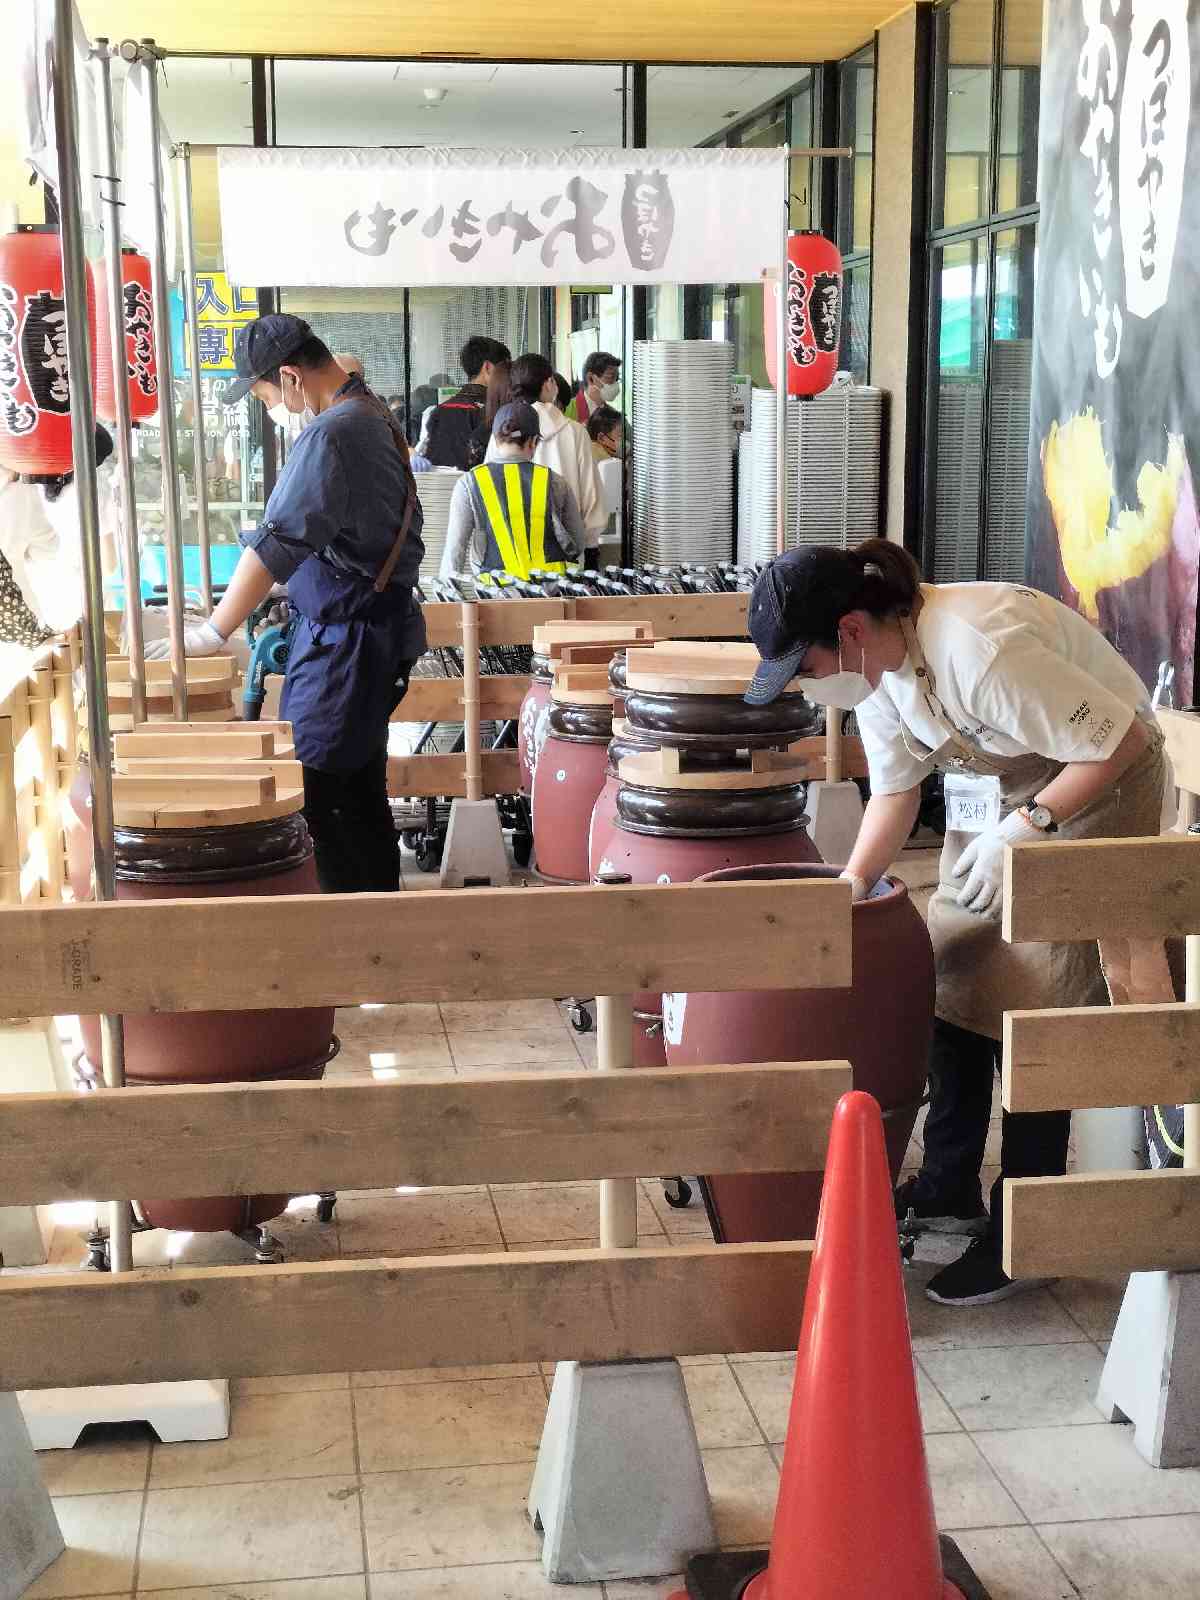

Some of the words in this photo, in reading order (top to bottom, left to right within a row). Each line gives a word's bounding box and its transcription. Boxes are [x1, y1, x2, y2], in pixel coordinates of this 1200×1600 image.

[1137, 18, 1174, 281] つぼやき
[199, 327, 249, 363] 専
[136, 429, 182, 438] ROADE
[184, 429, 223, 438] STION
